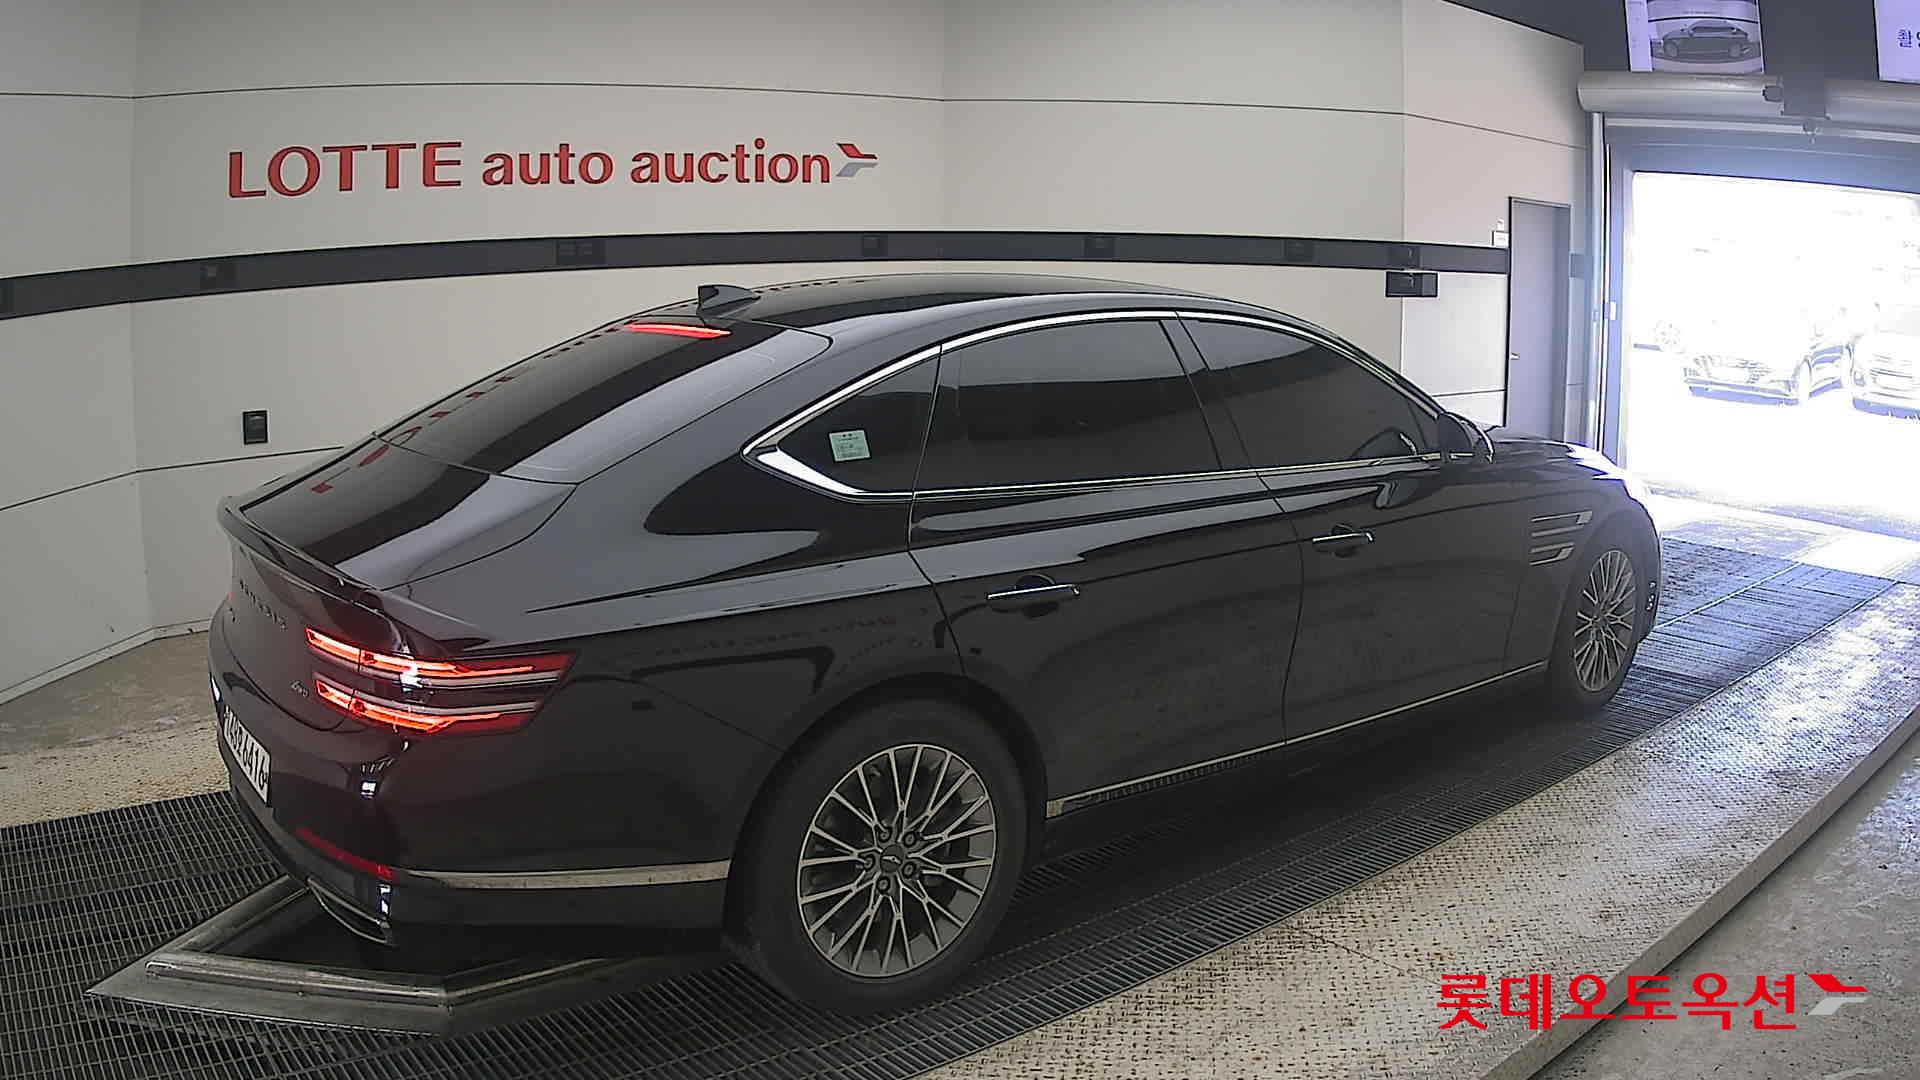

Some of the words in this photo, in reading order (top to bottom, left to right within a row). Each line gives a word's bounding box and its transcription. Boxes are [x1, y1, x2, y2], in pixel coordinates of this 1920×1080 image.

[228, 141, 463, 198] LOTTE
[482, 143, 614, 186] auto
[630, 138, 831, 185] auction
